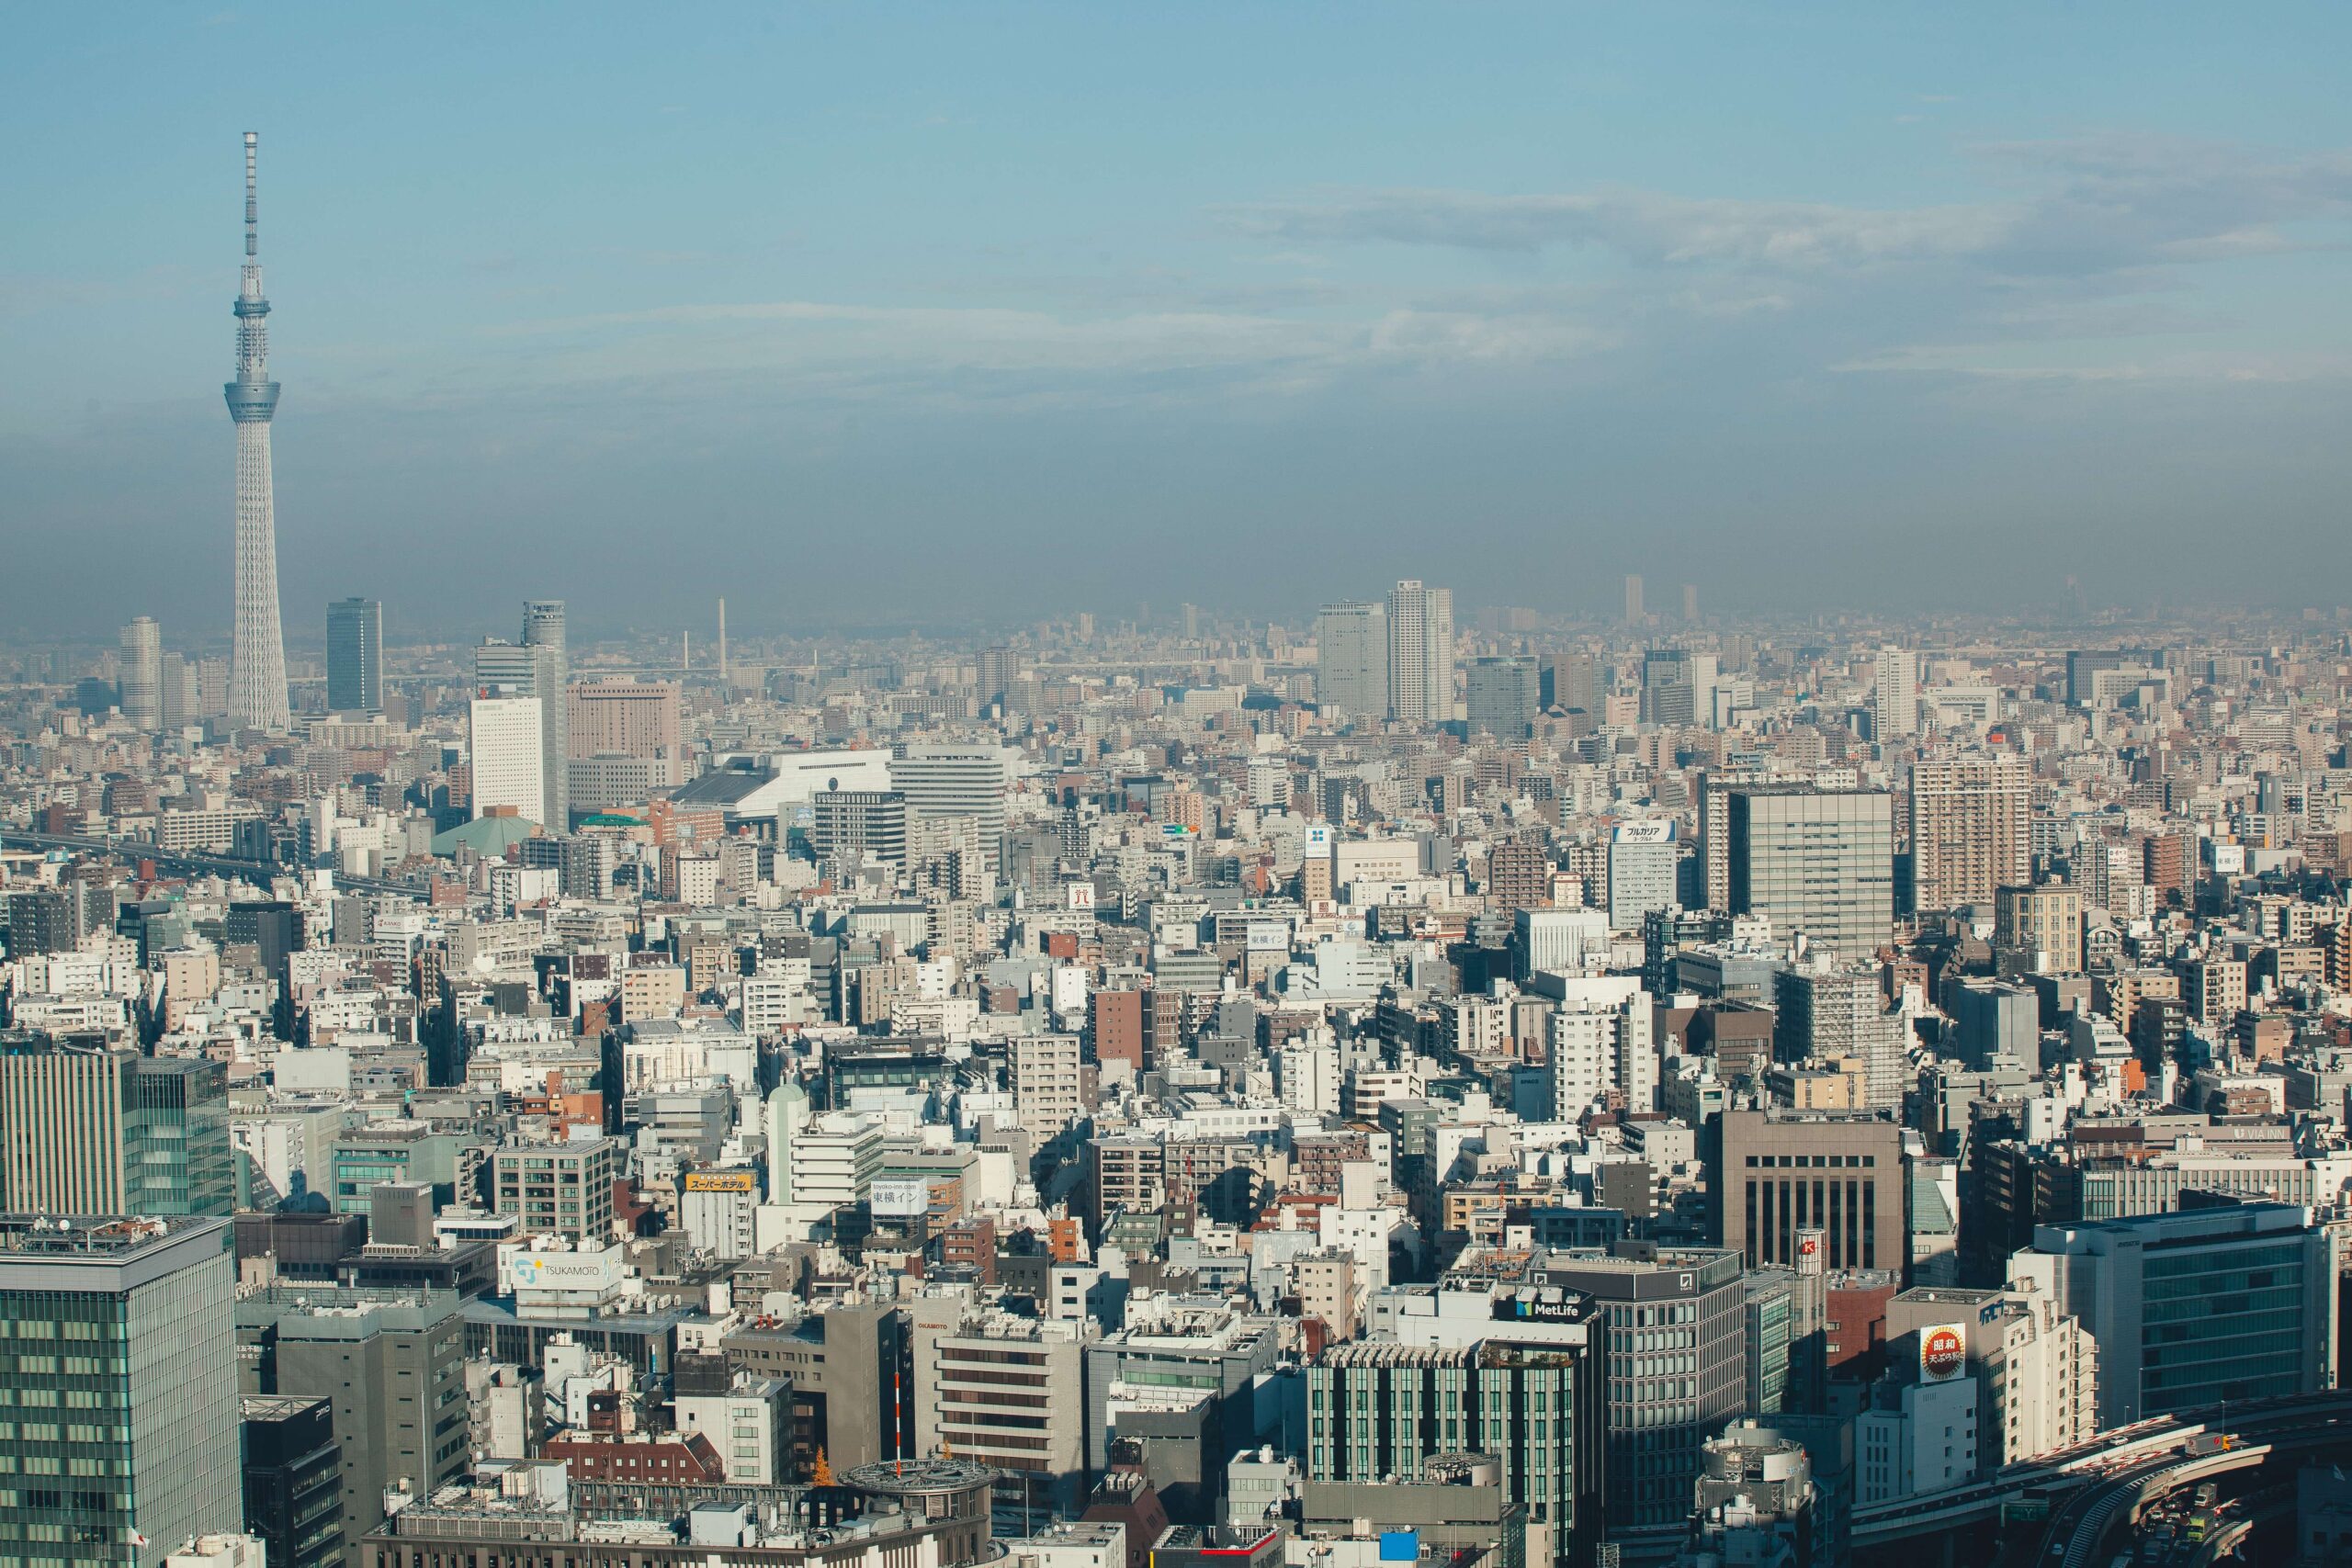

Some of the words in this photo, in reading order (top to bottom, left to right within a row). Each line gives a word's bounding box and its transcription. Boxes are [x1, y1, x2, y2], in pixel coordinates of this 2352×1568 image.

[1627, 827, 1660, 836] ブルガリア
[1251, 934, 1284, 944] 東横イン
[2247, 1129, 2266, 1140] VIA
[2267, 1129, 2285, 1140] INN
[691, 1180, 746, 1189] スーパーホテル
[873, 1183, 917, 1191] toyoko-inn.com
[873, 1191, 918, 1203] 東横イン
[544, 1265, 600, 1276] TSUKAMOTO
[1534, 1303, 1578, 1316] MetLife
[1933, 1338, 1956, 1351] 昭和
[1928, 1350, 1961, 1364] 天ぷら粉
[315, 1404, 331, 1422] pmo
